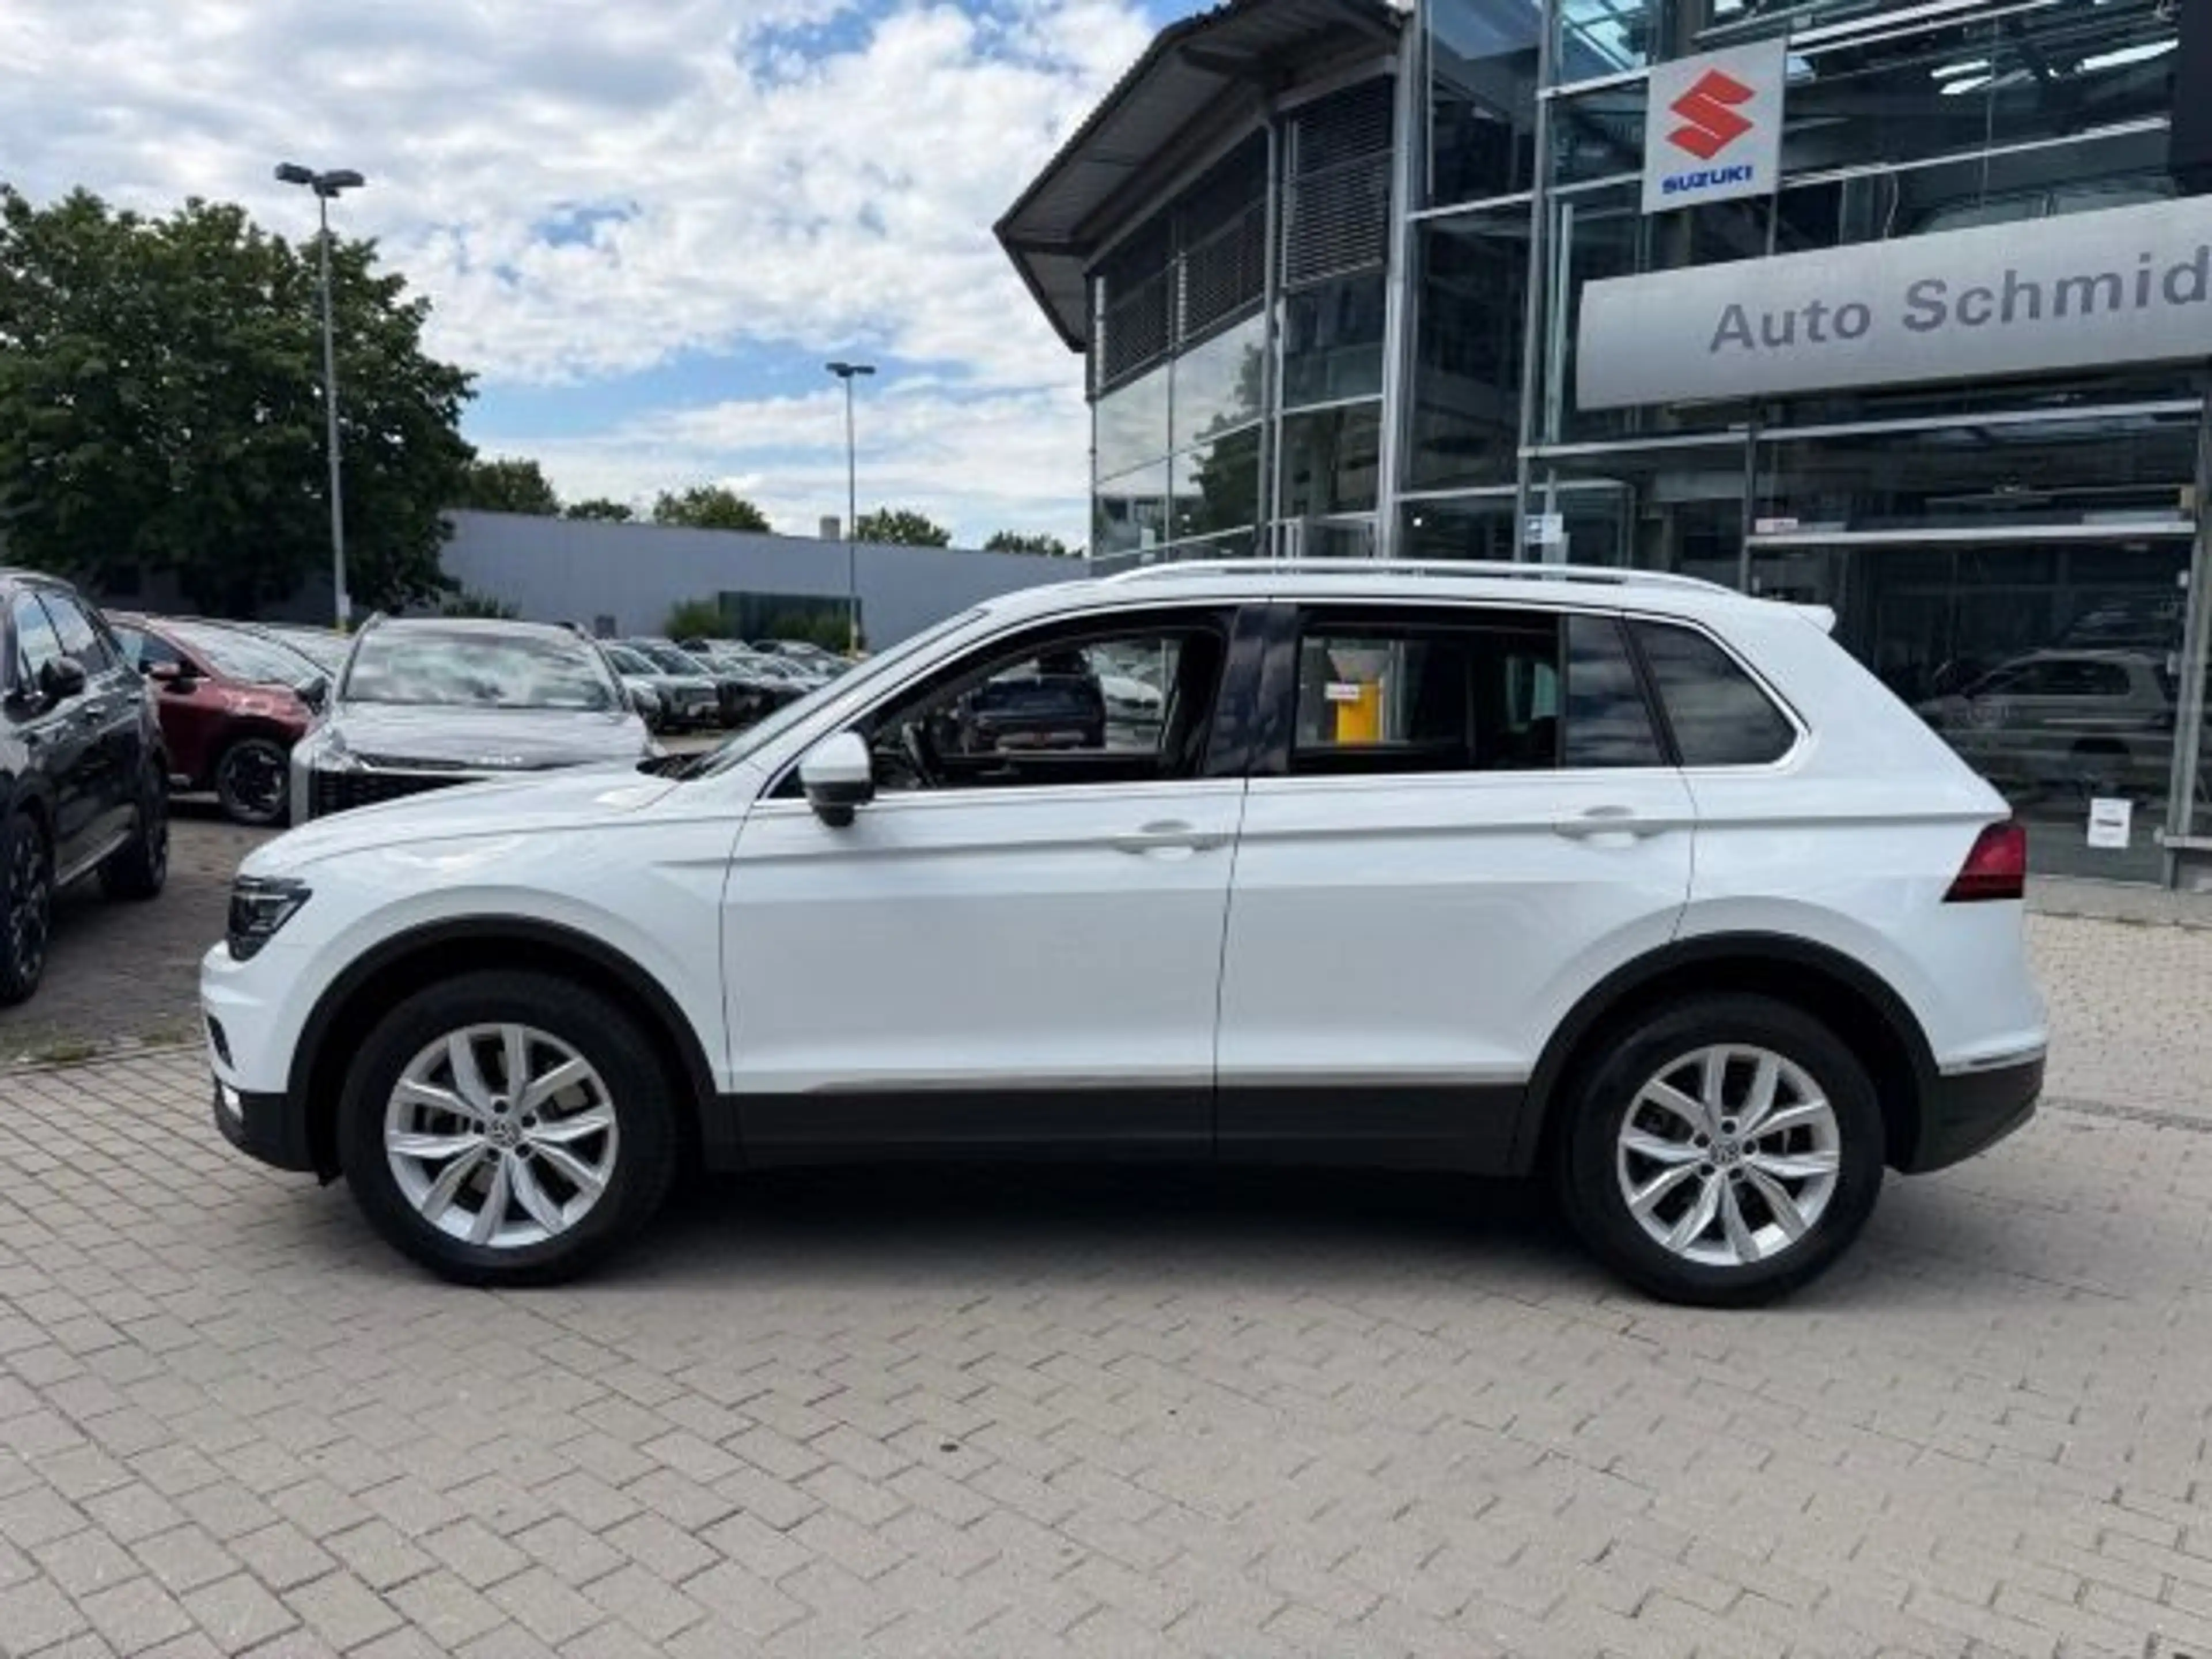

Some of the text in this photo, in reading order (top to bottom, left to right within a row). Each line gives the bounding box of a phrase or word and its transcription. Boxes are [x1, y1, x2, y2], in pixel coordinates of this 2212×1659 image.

[1662, 165, 1753, 194] SUZUKI
[1710, 245, 2211, 353] Auto Schmid
